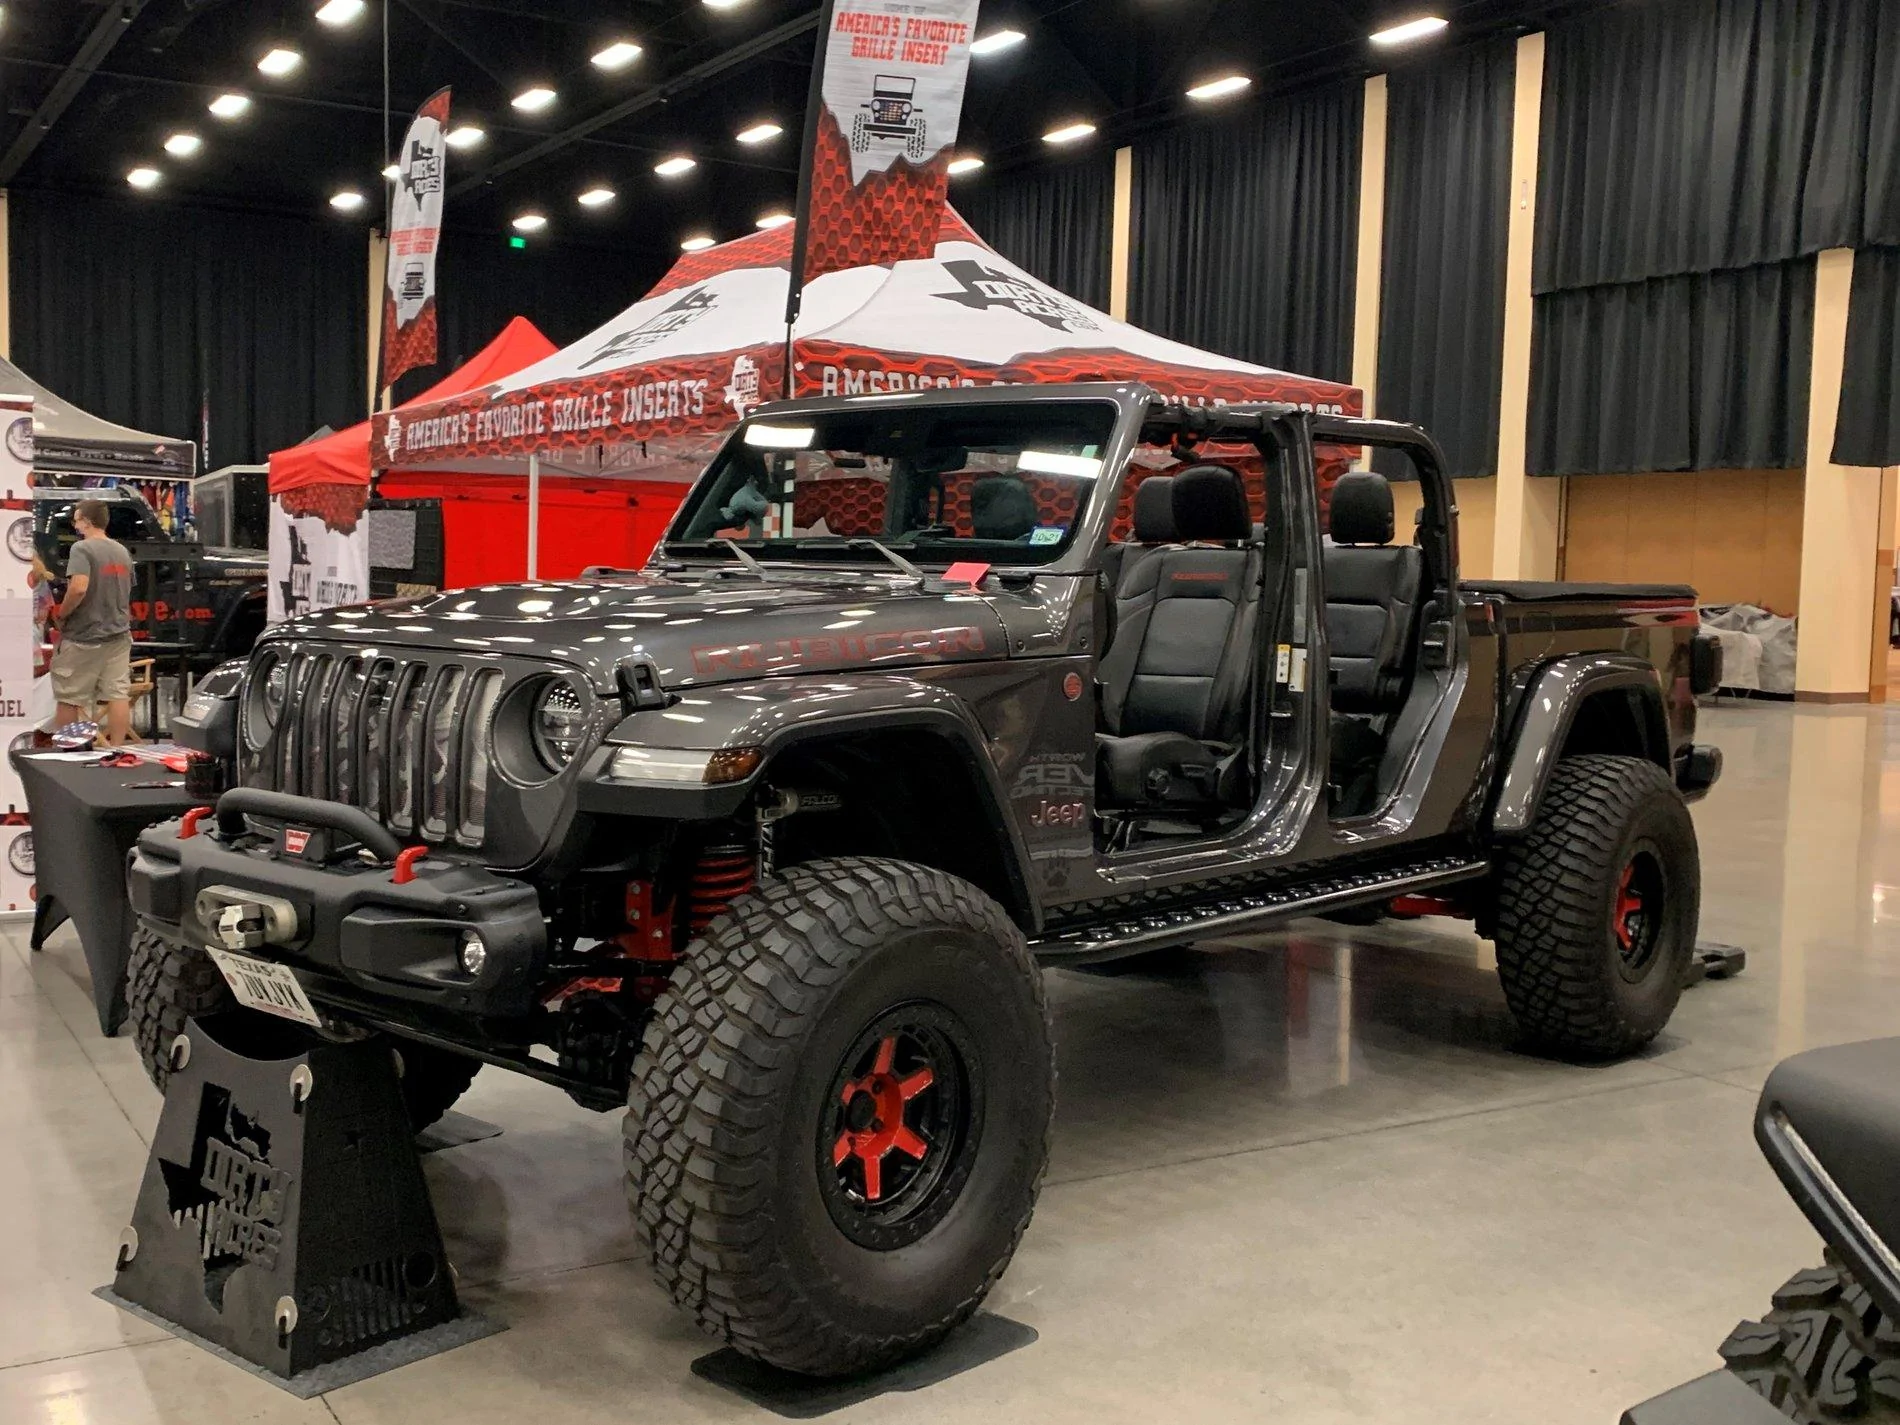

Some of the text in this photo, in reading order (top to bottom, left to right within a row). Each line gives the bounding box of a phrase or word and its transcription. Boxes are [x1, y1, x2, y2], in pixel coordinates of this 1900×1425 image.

[836, 12, 968, 43] AMERICA'S FAVORITE
[851, 36, 949, 65] GRILLE INSERT
[406, 412, 471, 450] AMERICA'S
[475, 401, 545, 442] FAVORITE
[552, 391, 613, 431] GRILLE
[621, 378, 709, 423] INSERTS
[1030, 799, 1086, 828] Jeep
